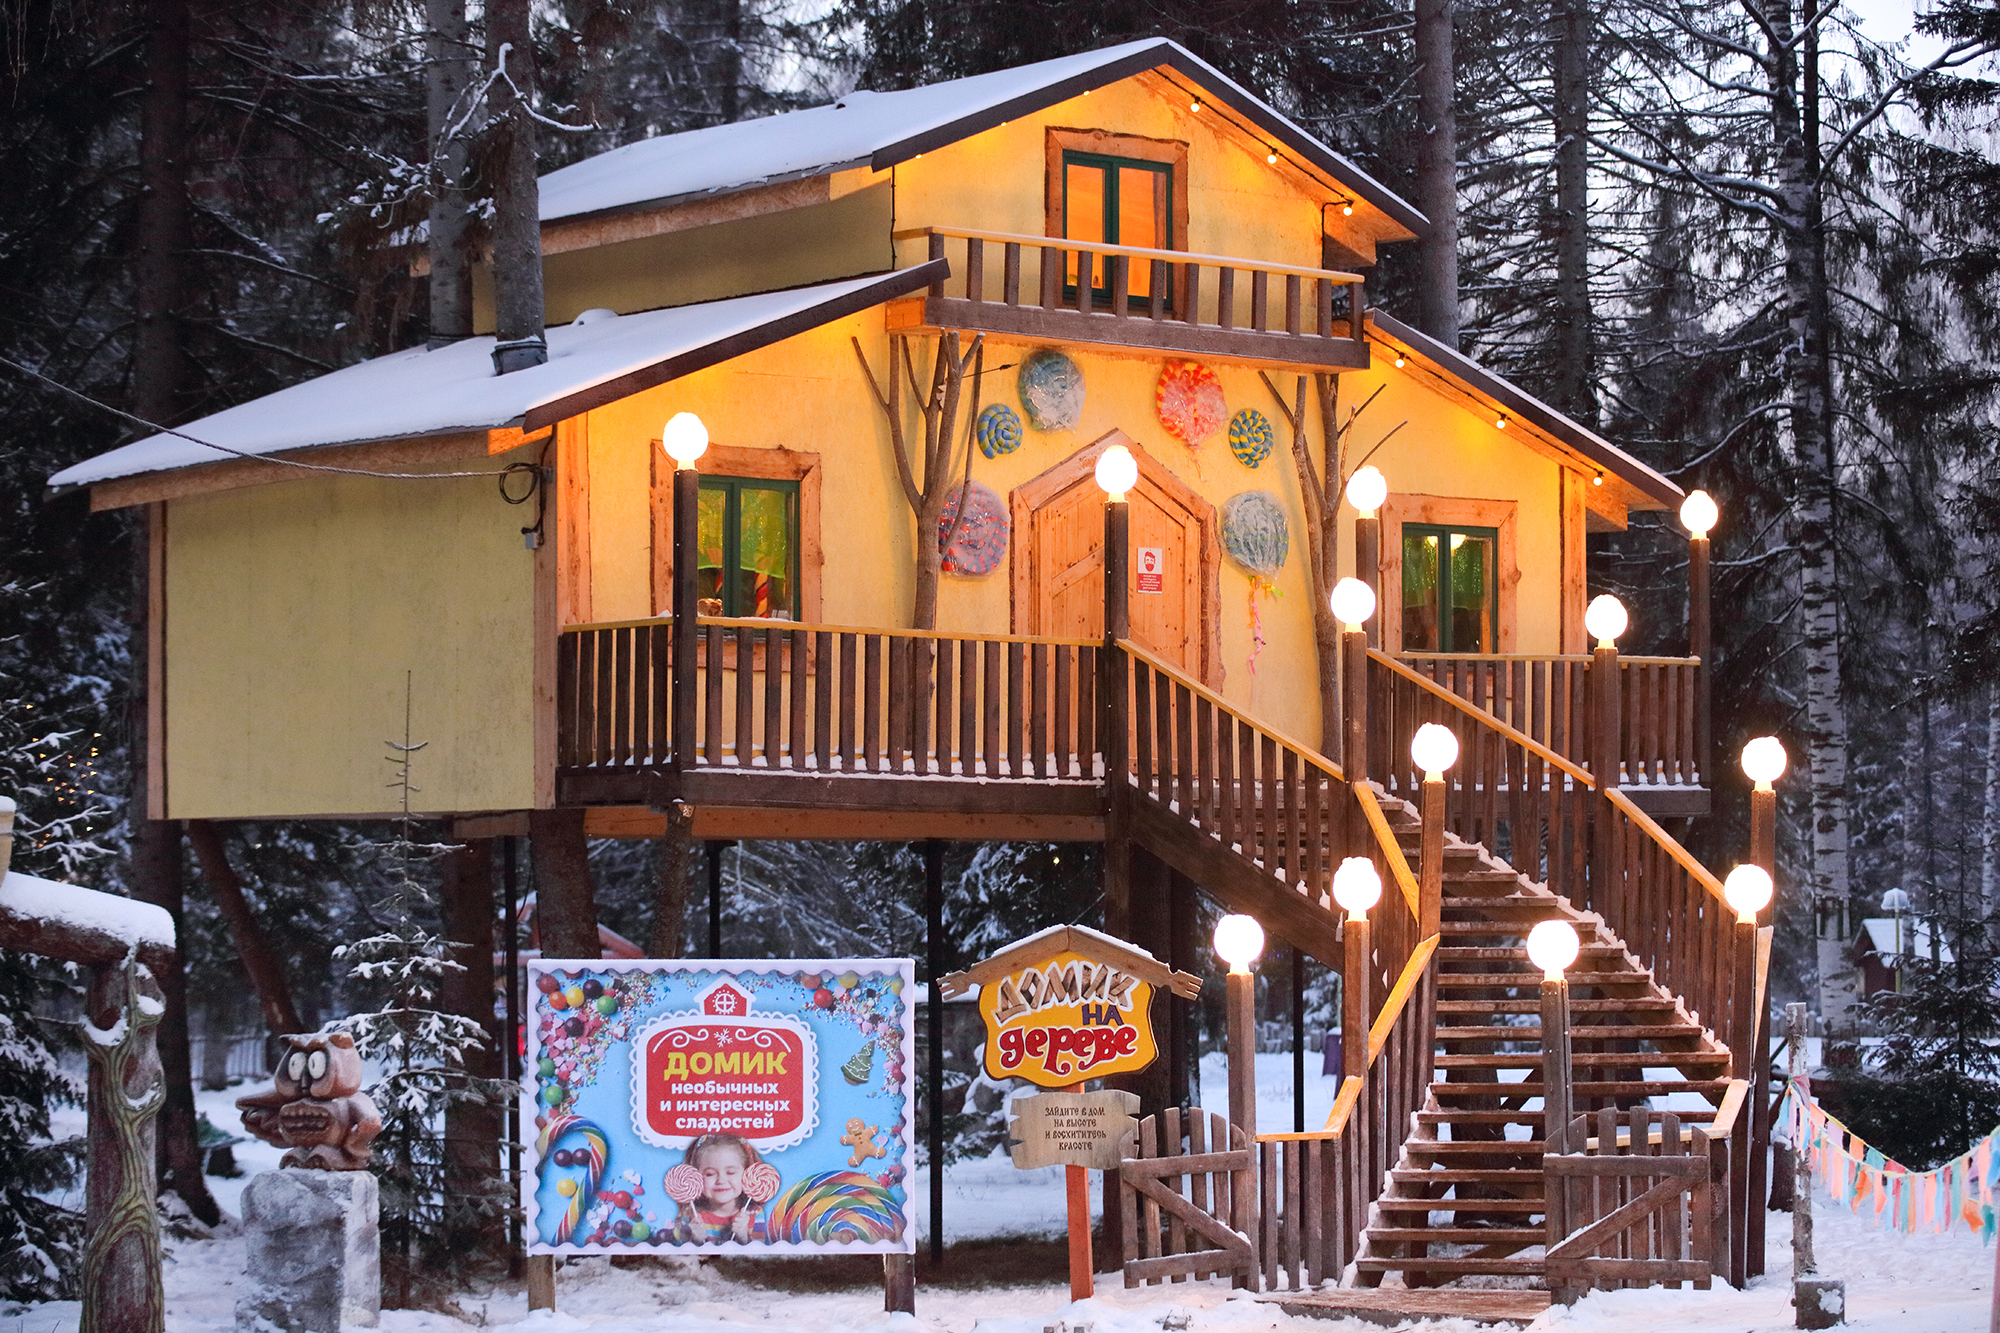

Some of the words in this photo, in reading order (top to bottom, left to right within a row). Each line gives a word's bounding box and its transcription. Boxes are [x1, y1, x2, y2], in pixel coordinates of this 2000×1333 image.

[1081, 1003, 1124, 1026] НА
[663, 1051, 788, 1081] ДОМИК
[671, 1080, 779, 1095] необычных
[660, 1100, 672, 1112] и
[676, 1099, 790, 1115] интересных
[1045, 1106, 1079, 1117] ЗАЙДИТЕ
[1081, 1106, 1087, 1116] В
[1088, 1106, 1105, 1117] ДОМ
[675, 1113, 775, 1132] сладостей
[1054, 1119, 1064, 1128] НА
[1066, 1118, 1097, 1128] ВЫСОТЕ
[1045, 1130, 1051, 1139] И
[1052, 1130, 1107, 1140] ВОСХИТИТЕСЬ
[1058, 1141, 1093, 1151] КРАСОТЕ
